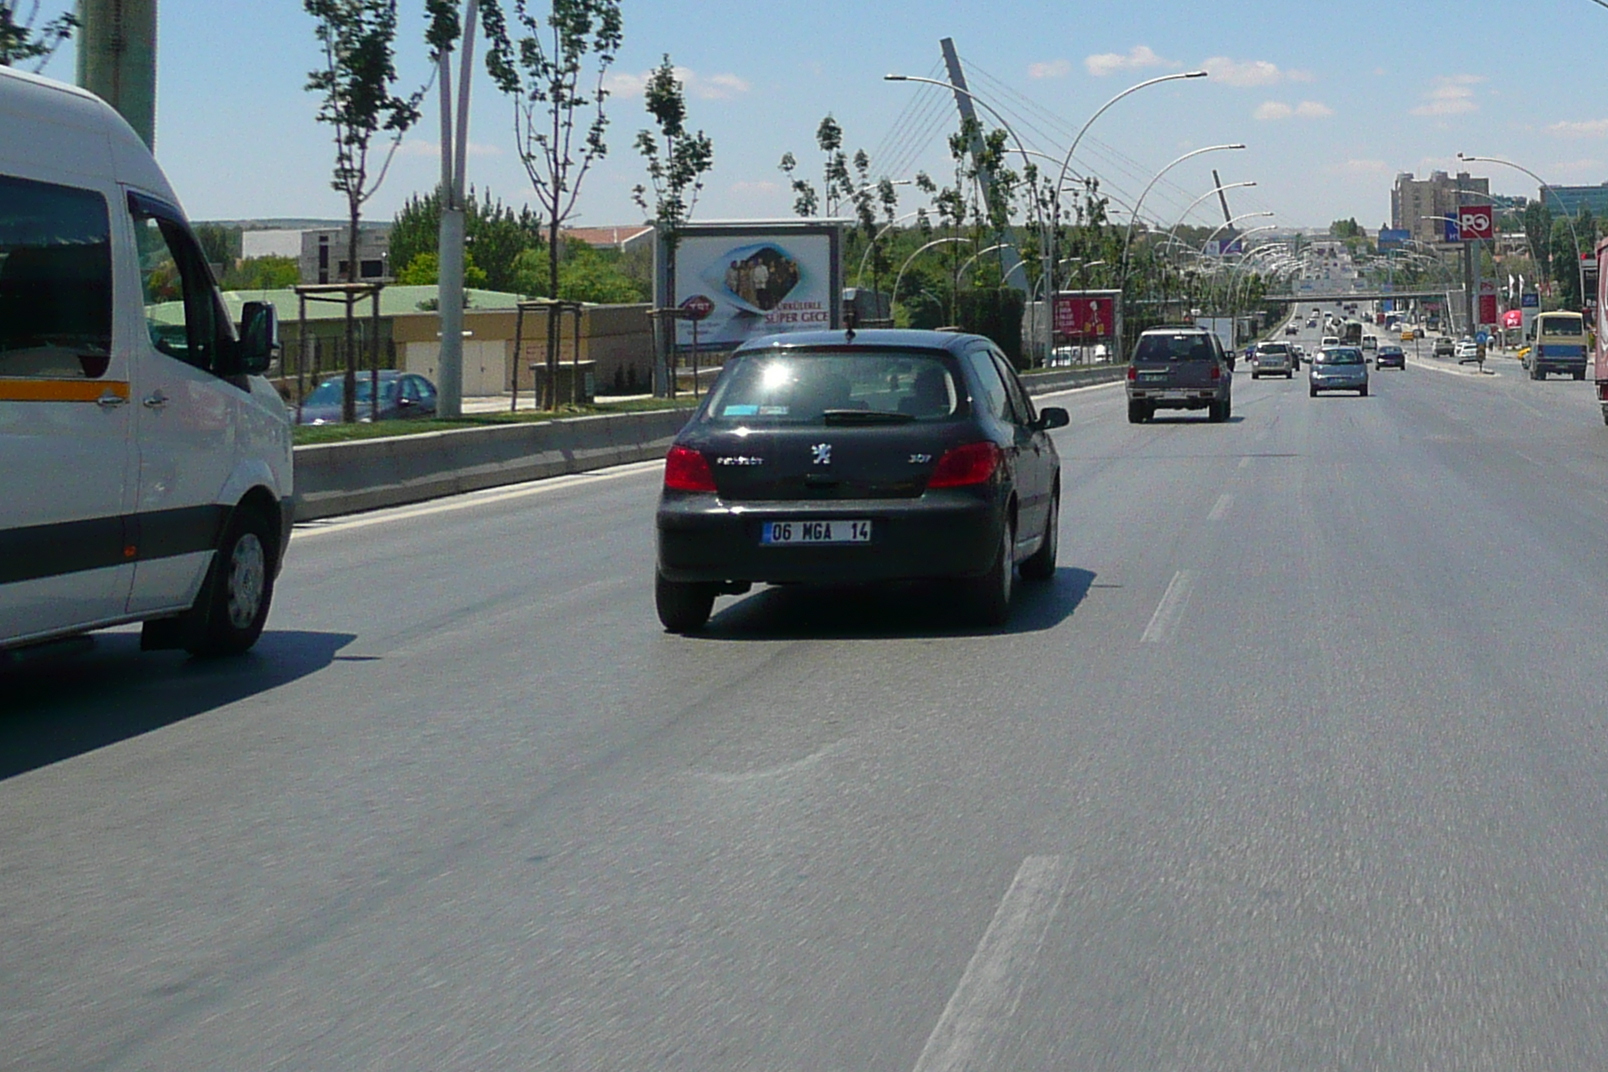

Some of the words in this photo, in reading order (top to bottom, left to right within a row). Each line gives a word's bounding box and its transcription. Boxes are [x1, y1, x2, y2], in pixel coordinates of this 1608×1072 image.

[801, 311, 829, 323] GECE
[908, 453, 932, 465] 307
[773, 521, 792, 541] 06
[802, 521, 832, 541] MGA
[851, 521, 868, 540] 14
